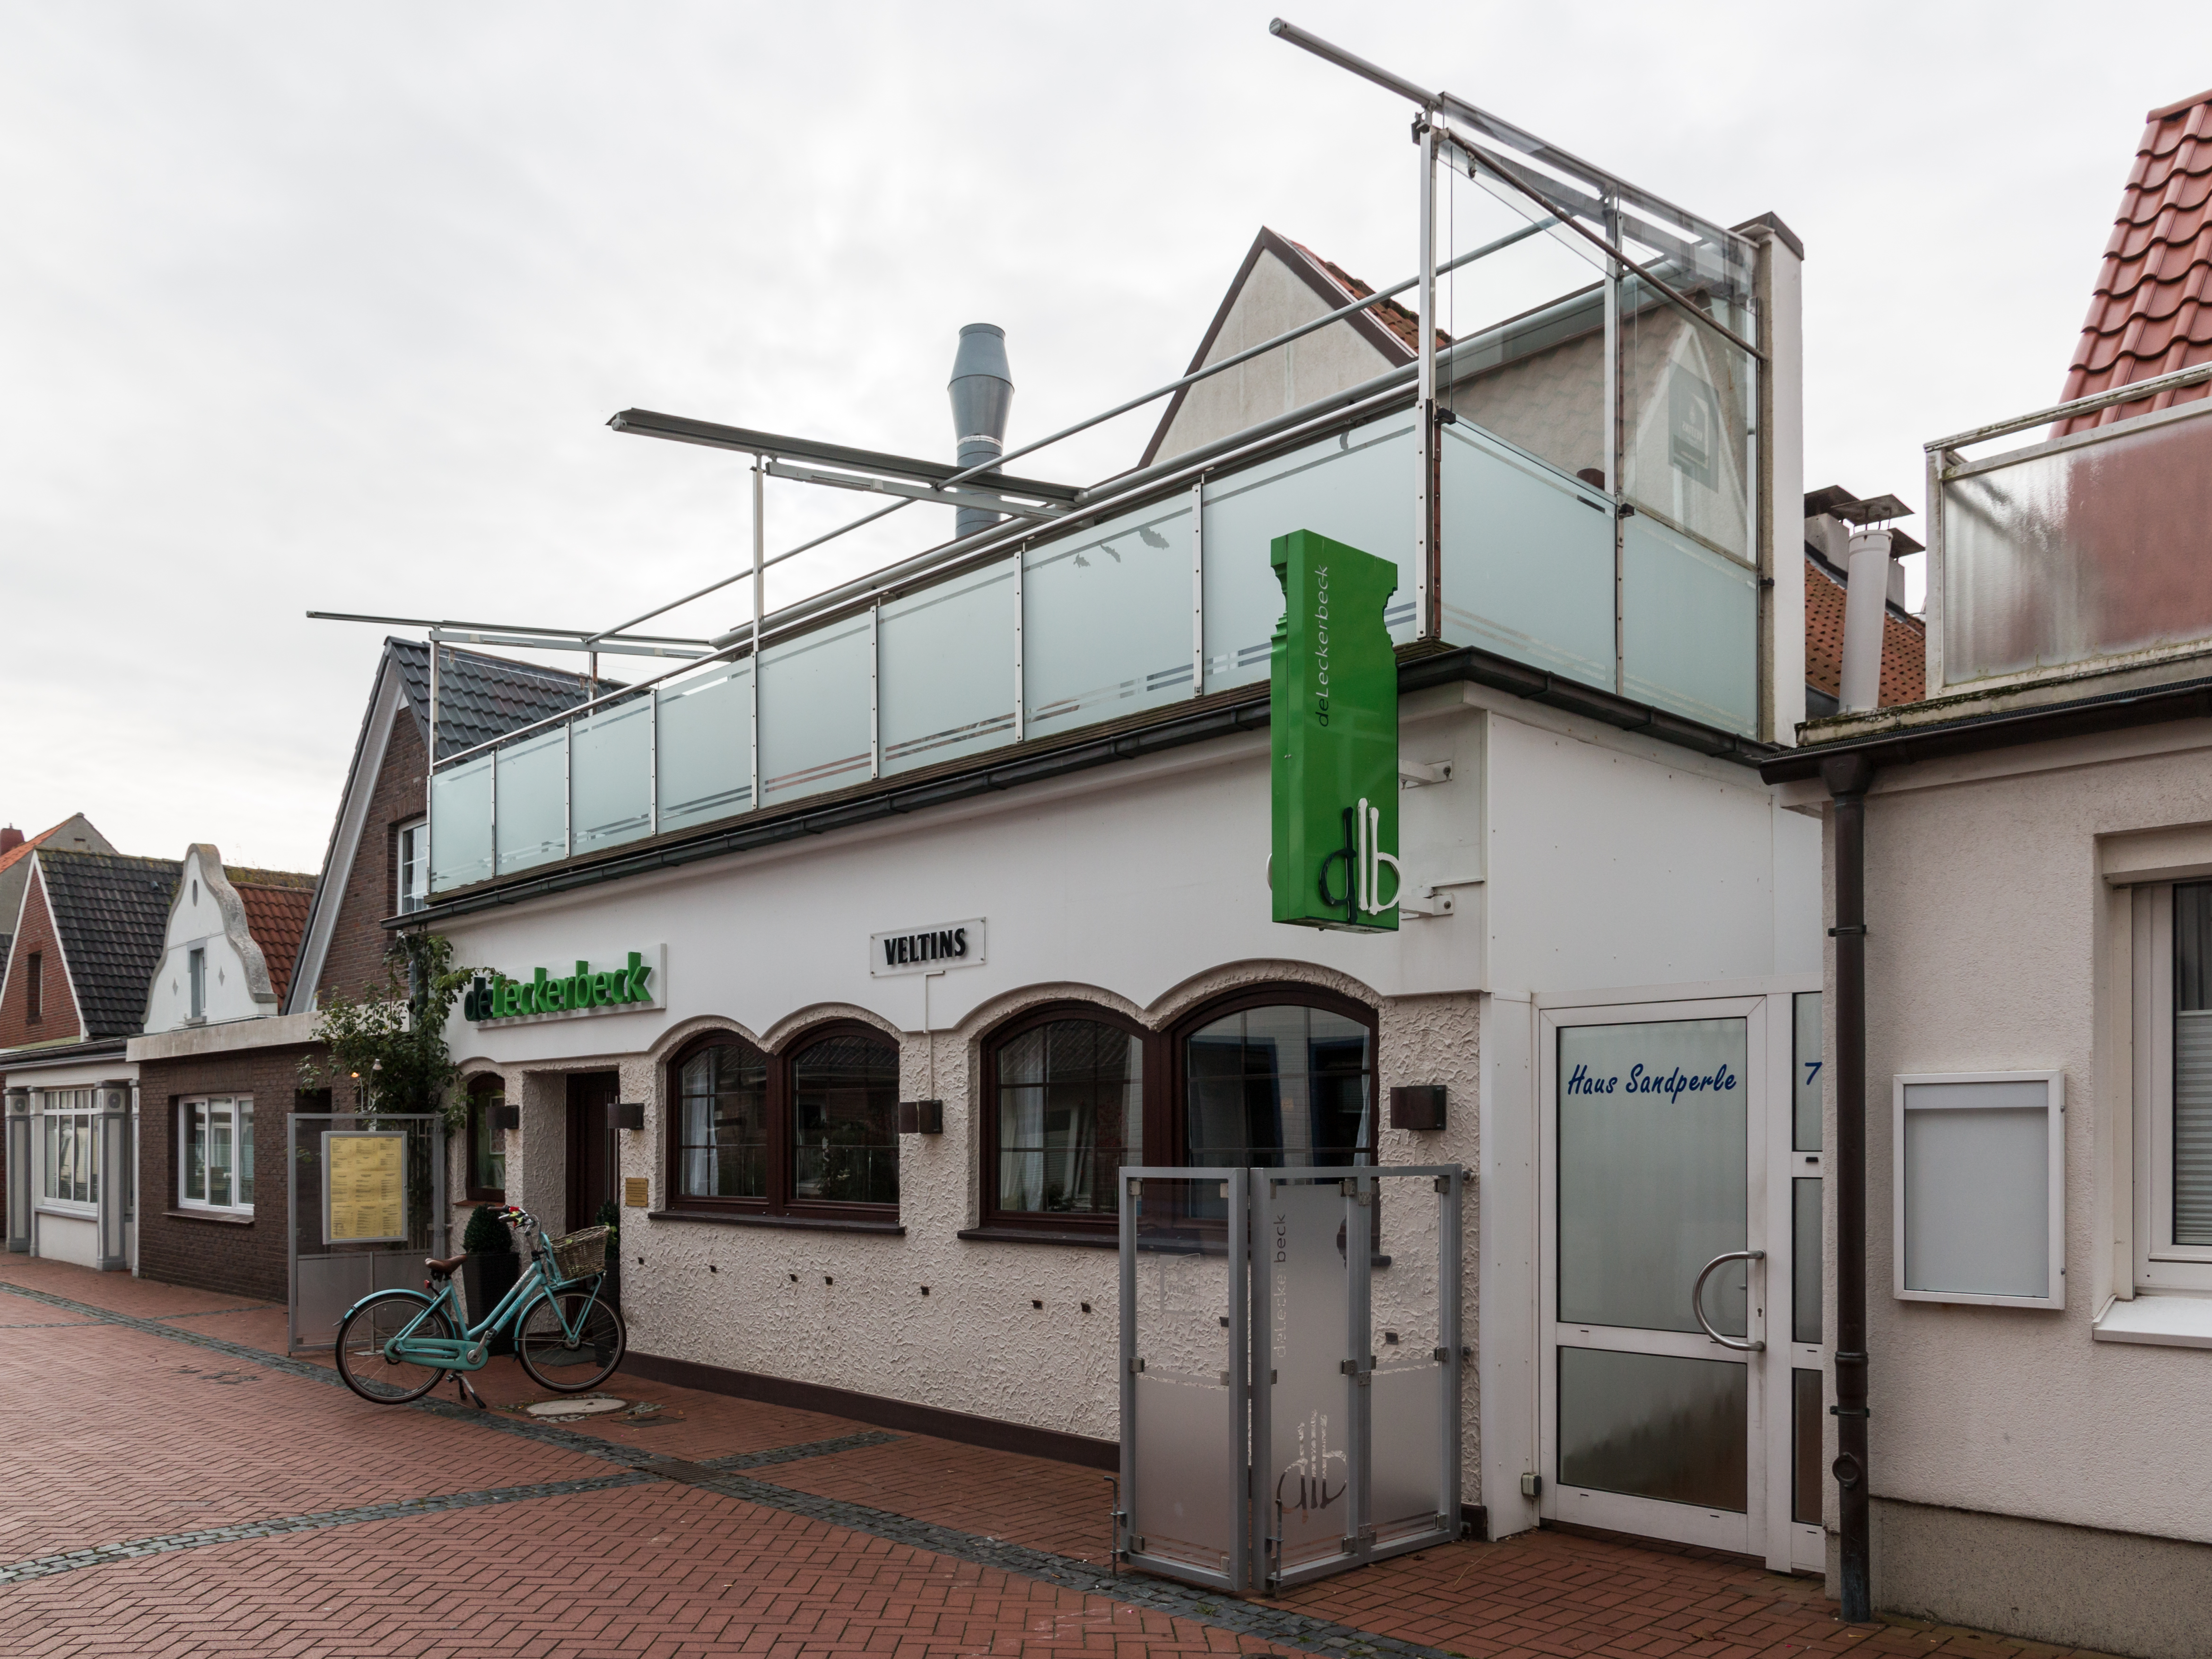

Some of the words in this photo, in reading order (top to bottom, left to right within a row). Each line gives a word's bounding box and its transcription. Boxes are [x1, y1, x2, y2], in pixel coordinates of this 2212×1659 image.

[884, 928, 966, 966] VELTINS
[1568, 1064, 1618, 1095] Haus
[1626, 1063, 1736, 1104] Sandperle
[1804, 1062, 1822, 1085] 7
